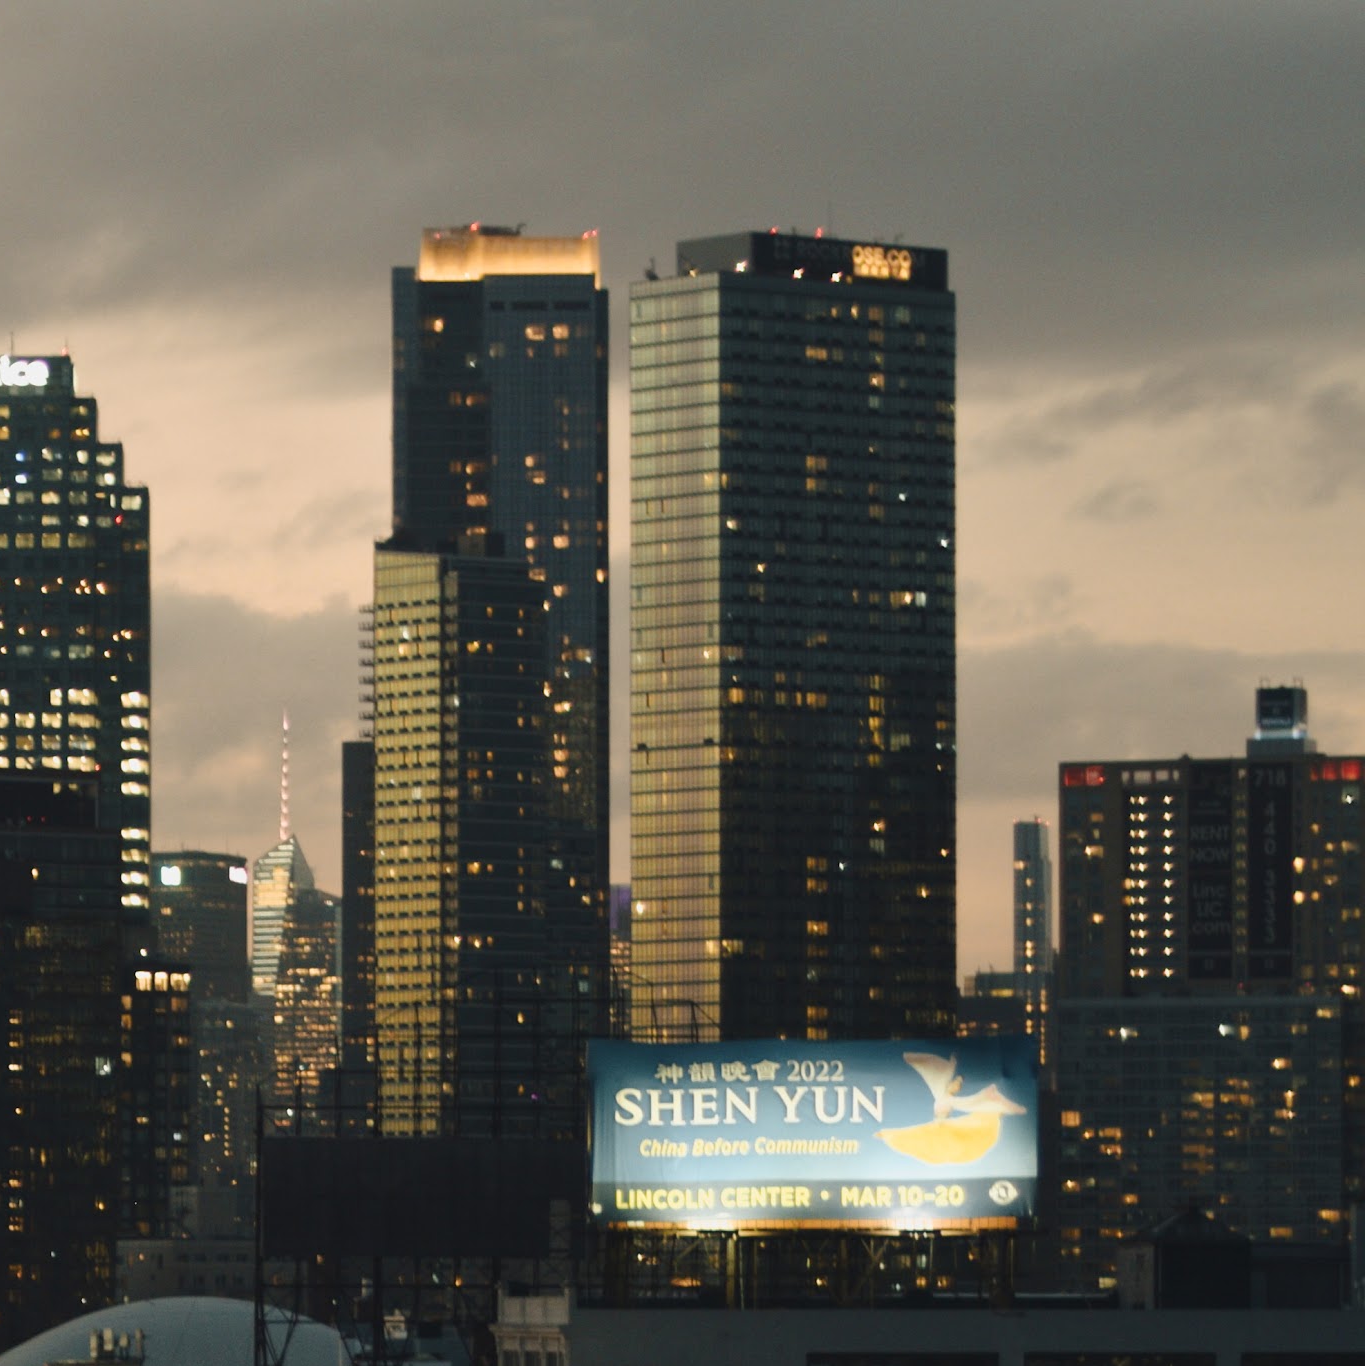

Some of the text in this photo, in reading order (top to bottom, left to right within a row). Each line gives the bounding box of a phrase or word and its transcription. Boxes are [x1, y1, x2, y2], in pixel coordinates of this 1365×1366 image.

[1253, 768, 1287, 788] 718
[1189, 824, 1229, 840] RENT
[1189, 847, 1230, 863] NOW
[787, 1060, 844, 1082] 2022
[614, 1086, 885, 1126] SHEN YUN
[639, 1136, 859, 1158] China Before Communism
[615, 1189, 714, 1210] LINCOLN
[721, 1187, 810, 1208] CENTER
[840, 1186, 891, 1207] MAR
